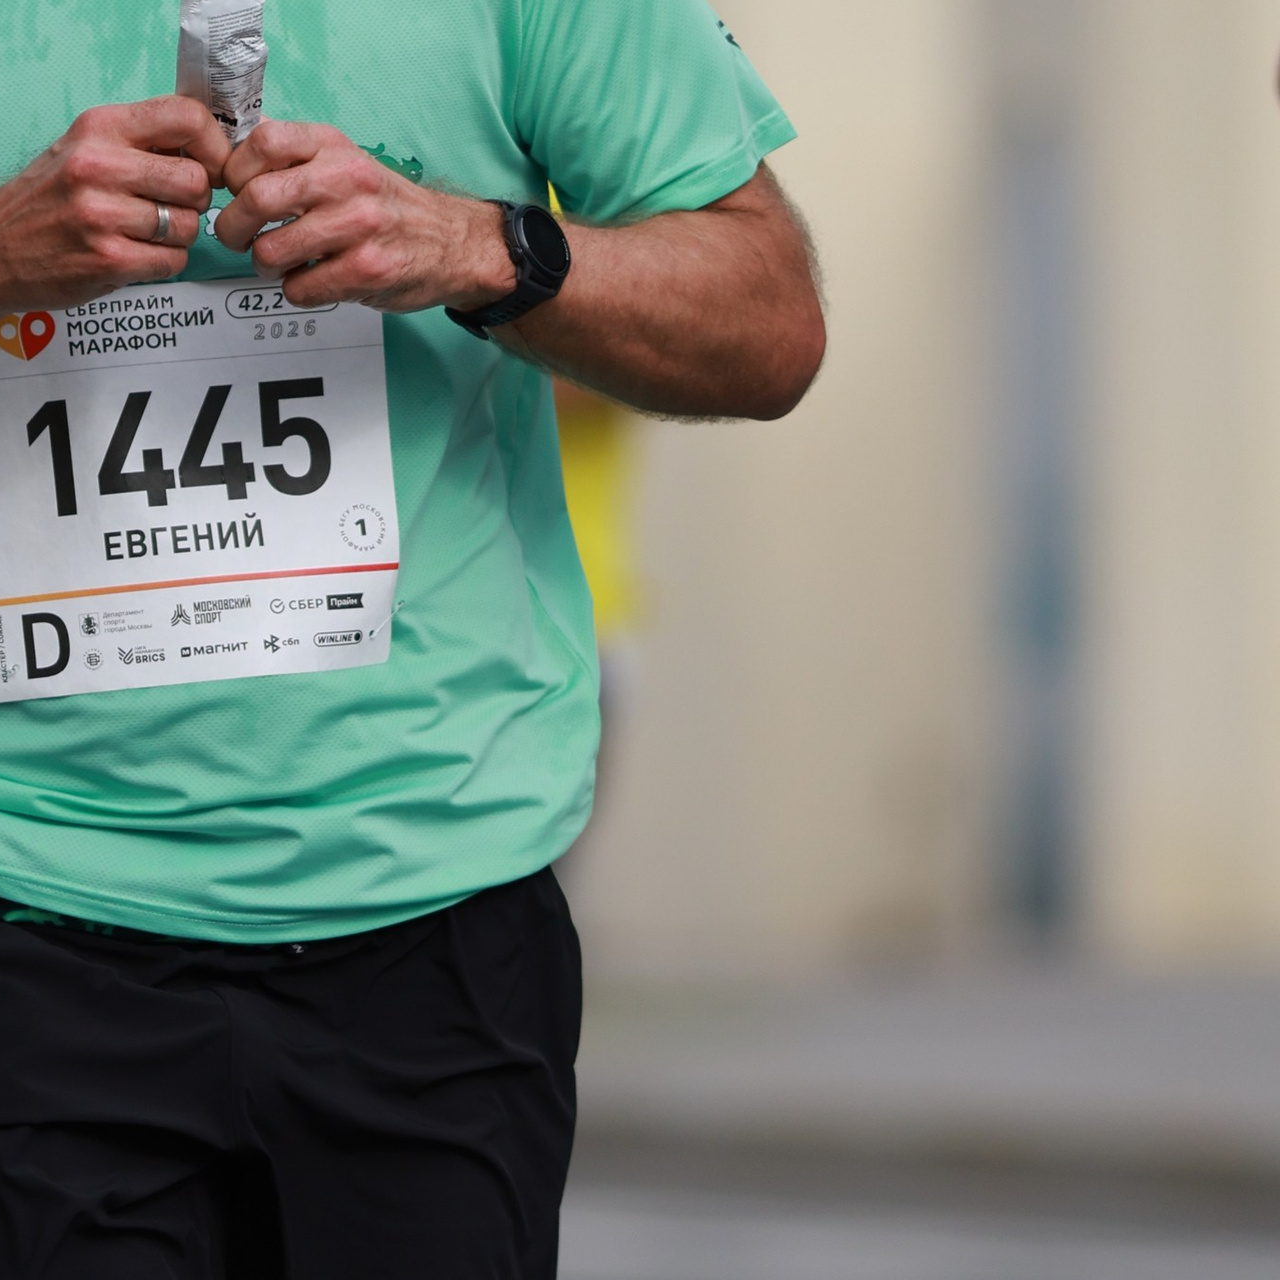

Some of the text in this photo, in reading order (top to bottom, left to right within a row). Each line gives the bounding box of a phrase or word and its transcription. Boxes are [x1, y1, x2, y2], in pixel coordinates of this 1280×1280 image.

[65, 296, 174, 318] СБЕРПРАЙМ
[238, 292, 284, 312] 42,2
[66, 309, 215, 338] МОСКОВСКИЙ
[254, 320, 316, 340] 2026
[68, 332, 178, 357] МАРАФОН
[26, 376, 332, 518] 1445
[104, 513, 264, 560] ЕВГЕНИЙ
[355, 519, 366, 535] 1
[192, 595, 252, 612] МОСКОВСКИЙ
[289, 597, 358, 610] СБЕР Прайм
[194, 611, 222, 625] СПОРТ
[22, 613, 70, 679] D
[282, 638, 299, 646] сбп
[317, 633, 354, 644] WINLINE
[135, 652, 165, 663] BRICS
